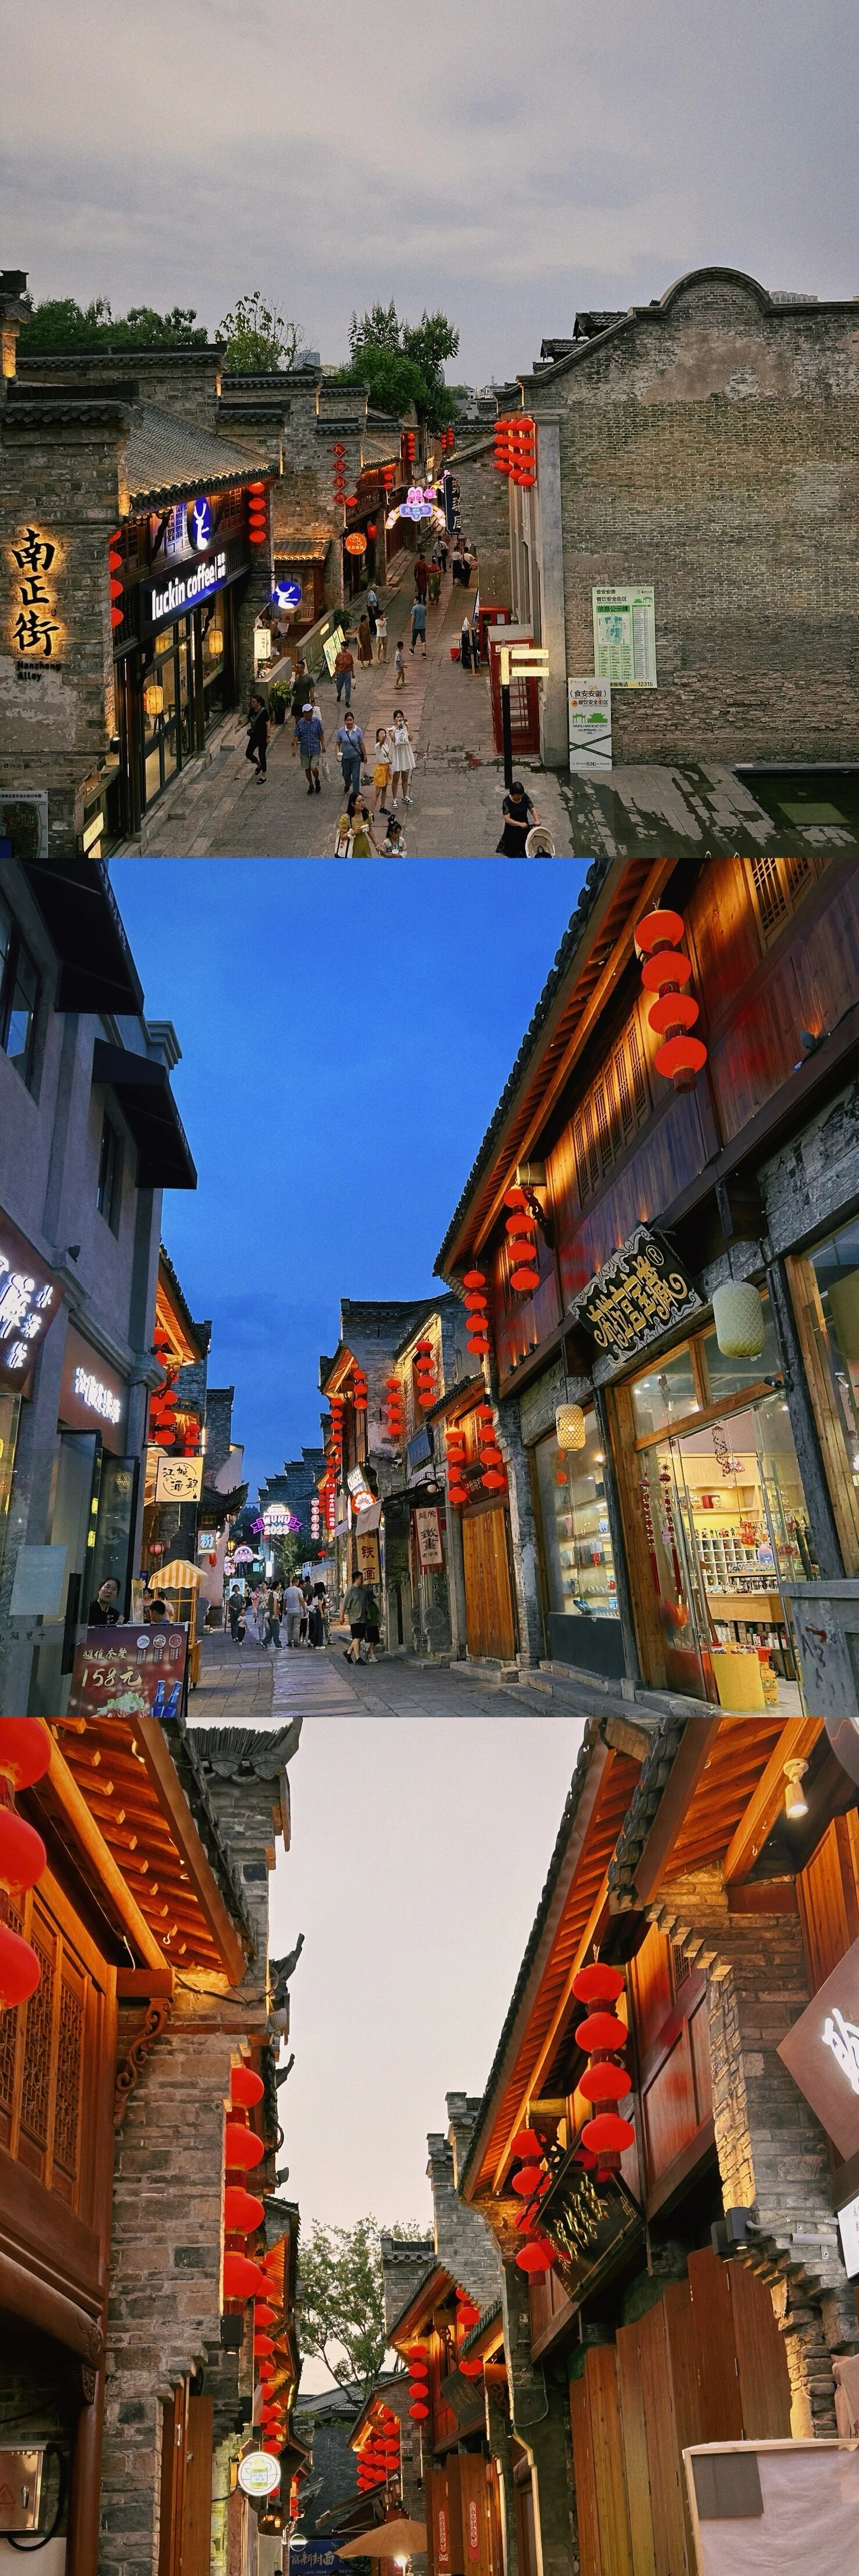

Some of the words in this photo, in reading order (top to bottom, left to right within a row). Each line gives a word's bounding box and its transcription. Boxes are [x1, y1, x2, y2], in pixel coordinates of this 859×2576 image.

[12, 528, 60, 657] 南正街
[152, 577, 185, 621] luckin
[187, 562, 215, 598] coffee
[17, 672, 41, 681] Alley
[163, 1464, 189, 1478] 江城
[263, 1516, 291, 1525] WUHU
[263, 1525, 290, 1535] 2023
[200, 1534, 214, 1548] 粉
[361, 1545, 376, 1581] 铁画
[83, 1647, 127, 1660] 超值套餐
[81, 1666, 142, 1687] 158元
